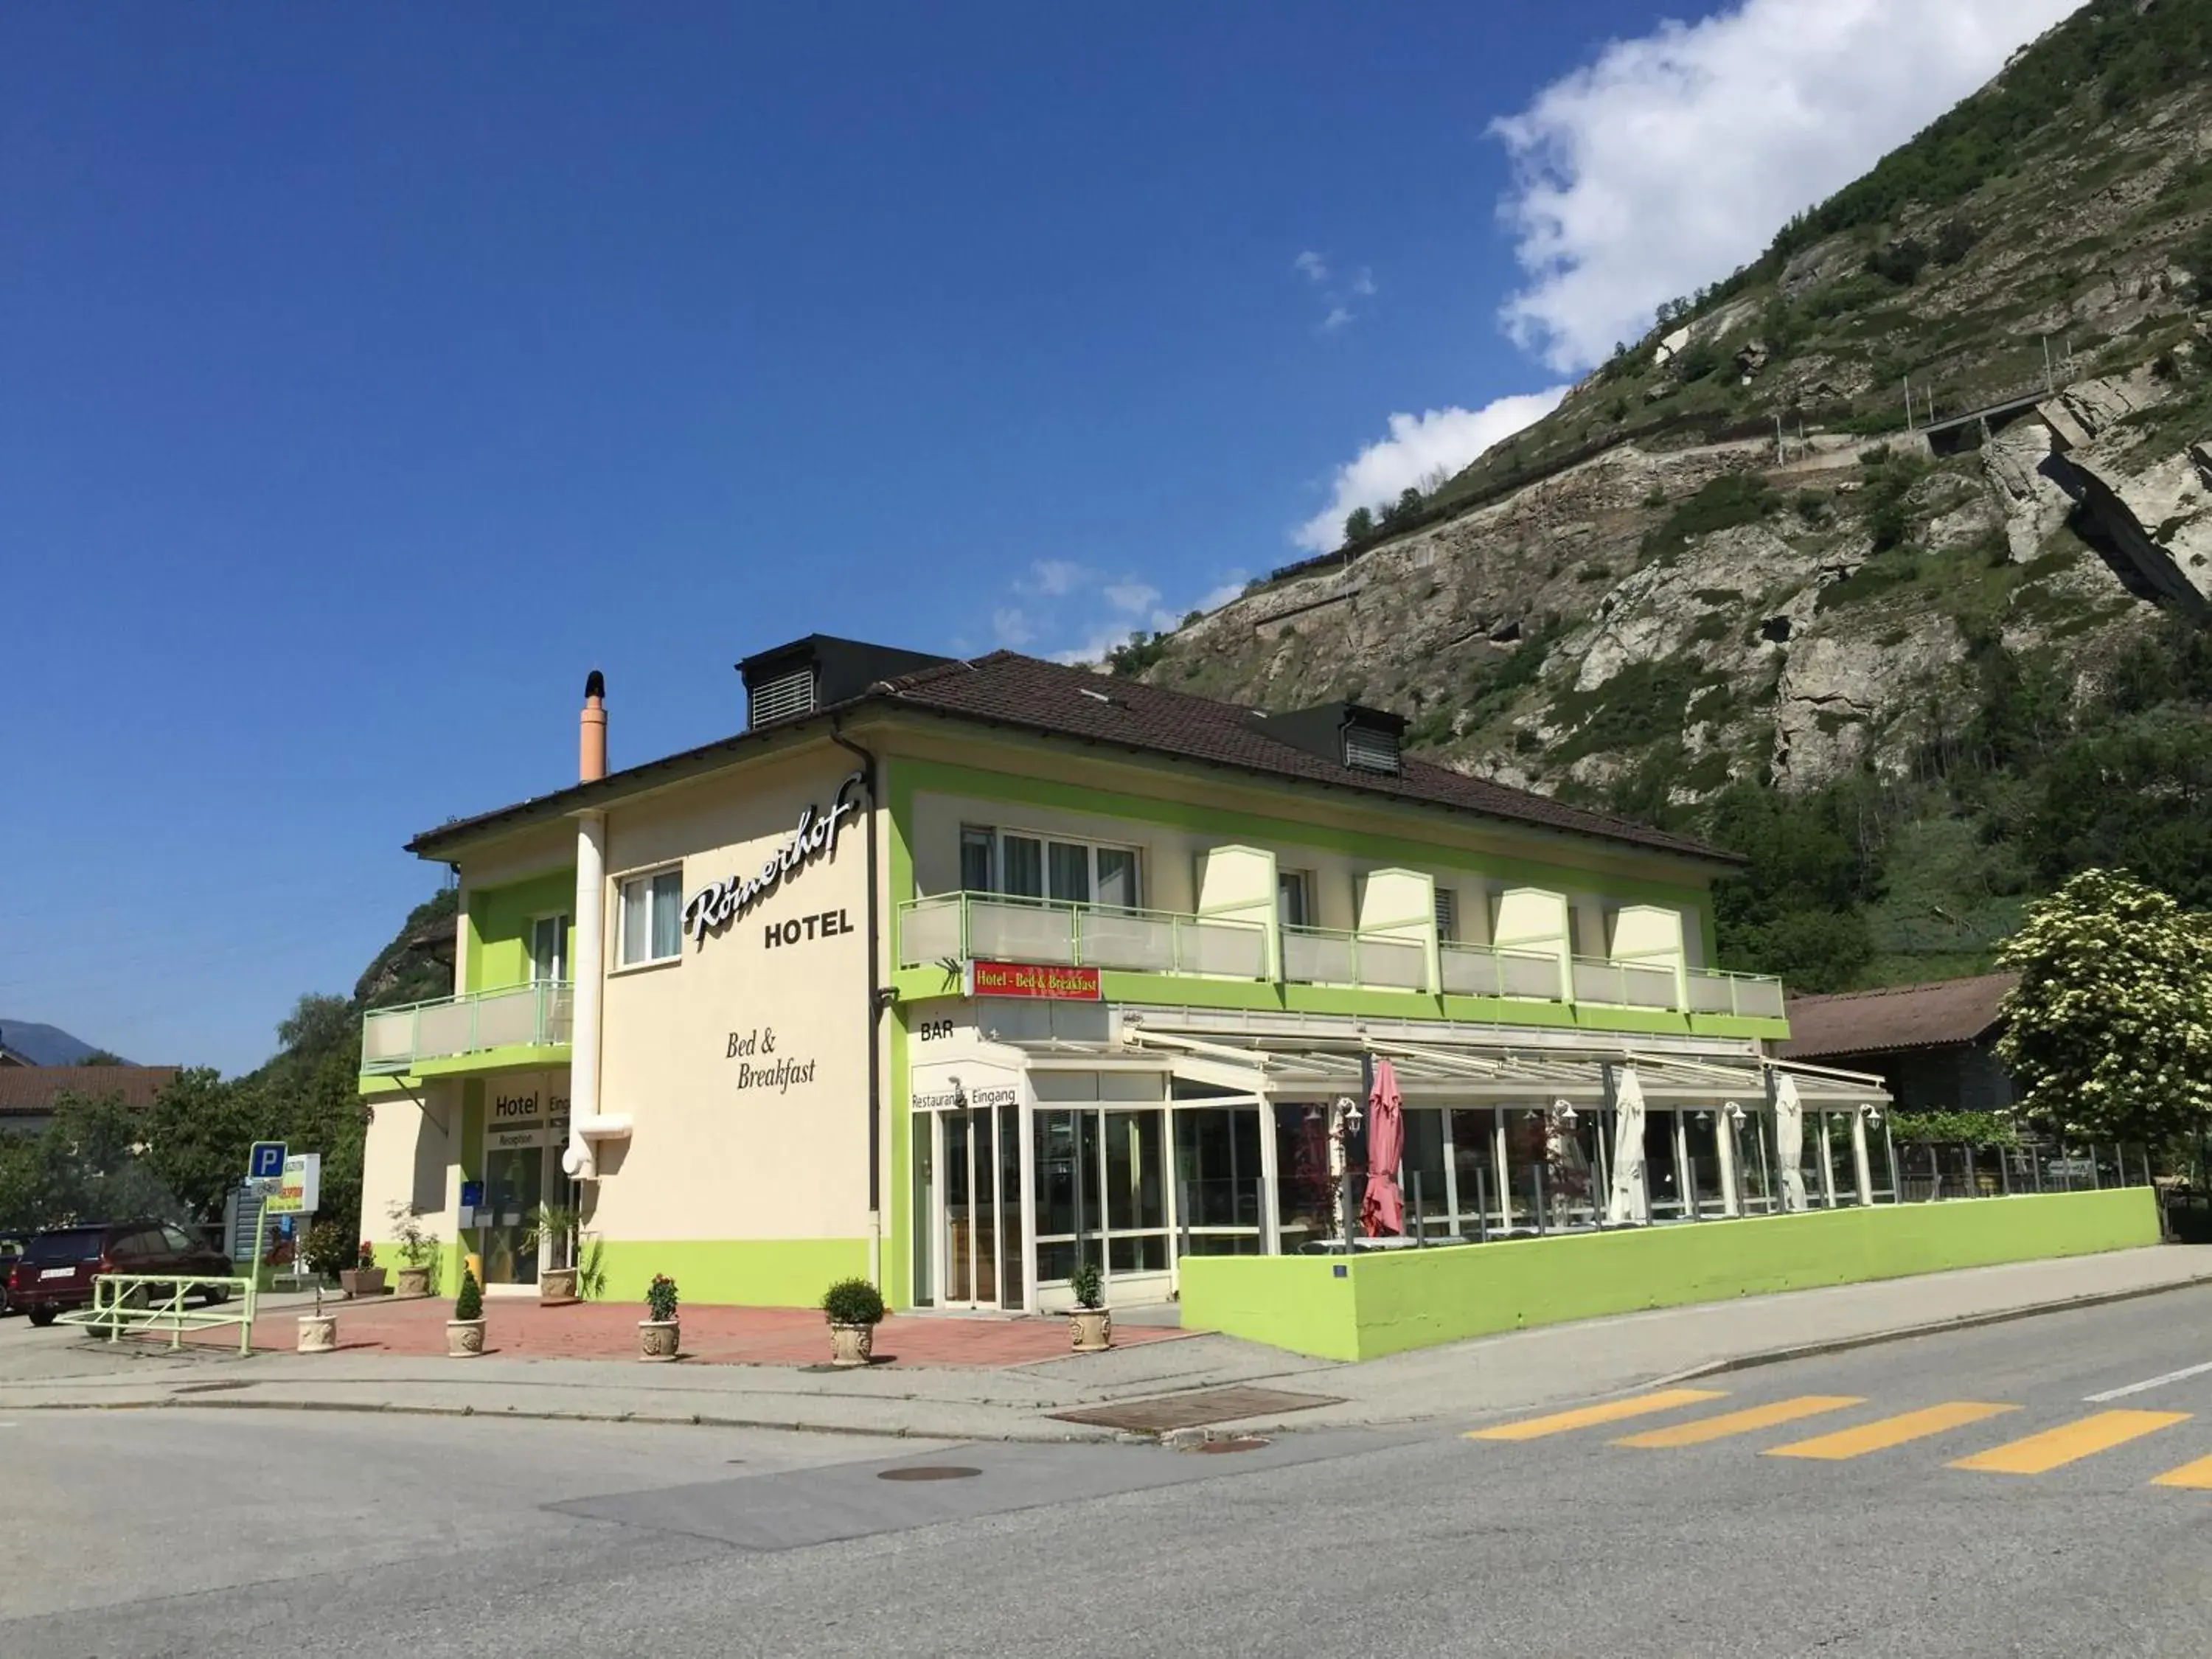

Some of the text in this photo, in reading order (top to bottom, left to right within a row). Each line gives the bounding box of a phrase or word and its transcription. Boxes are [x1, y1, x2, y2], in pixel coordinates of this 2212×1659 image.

[681, 771, 863, 944] Römerhof
[765, 908, 855, 949] HOTEL
[977, 970, 1006, 987] Hotel
[1015, 973, 1034, 988] Bed
[1037, 975, 1046, 990] &
[1048, 975, 1097, 992] Breakfast
[726, 1026, 776, 1059] Bed &
[921, 1019, 954, 1042] BAR
[737, 1057, 816, 1095] Breakfast
[495, 1091, 570, 1117] Hotel Eing
[912, 1089, 1016, 1109] Restauran Eingang
[261, 1150, 277, 1175] P
